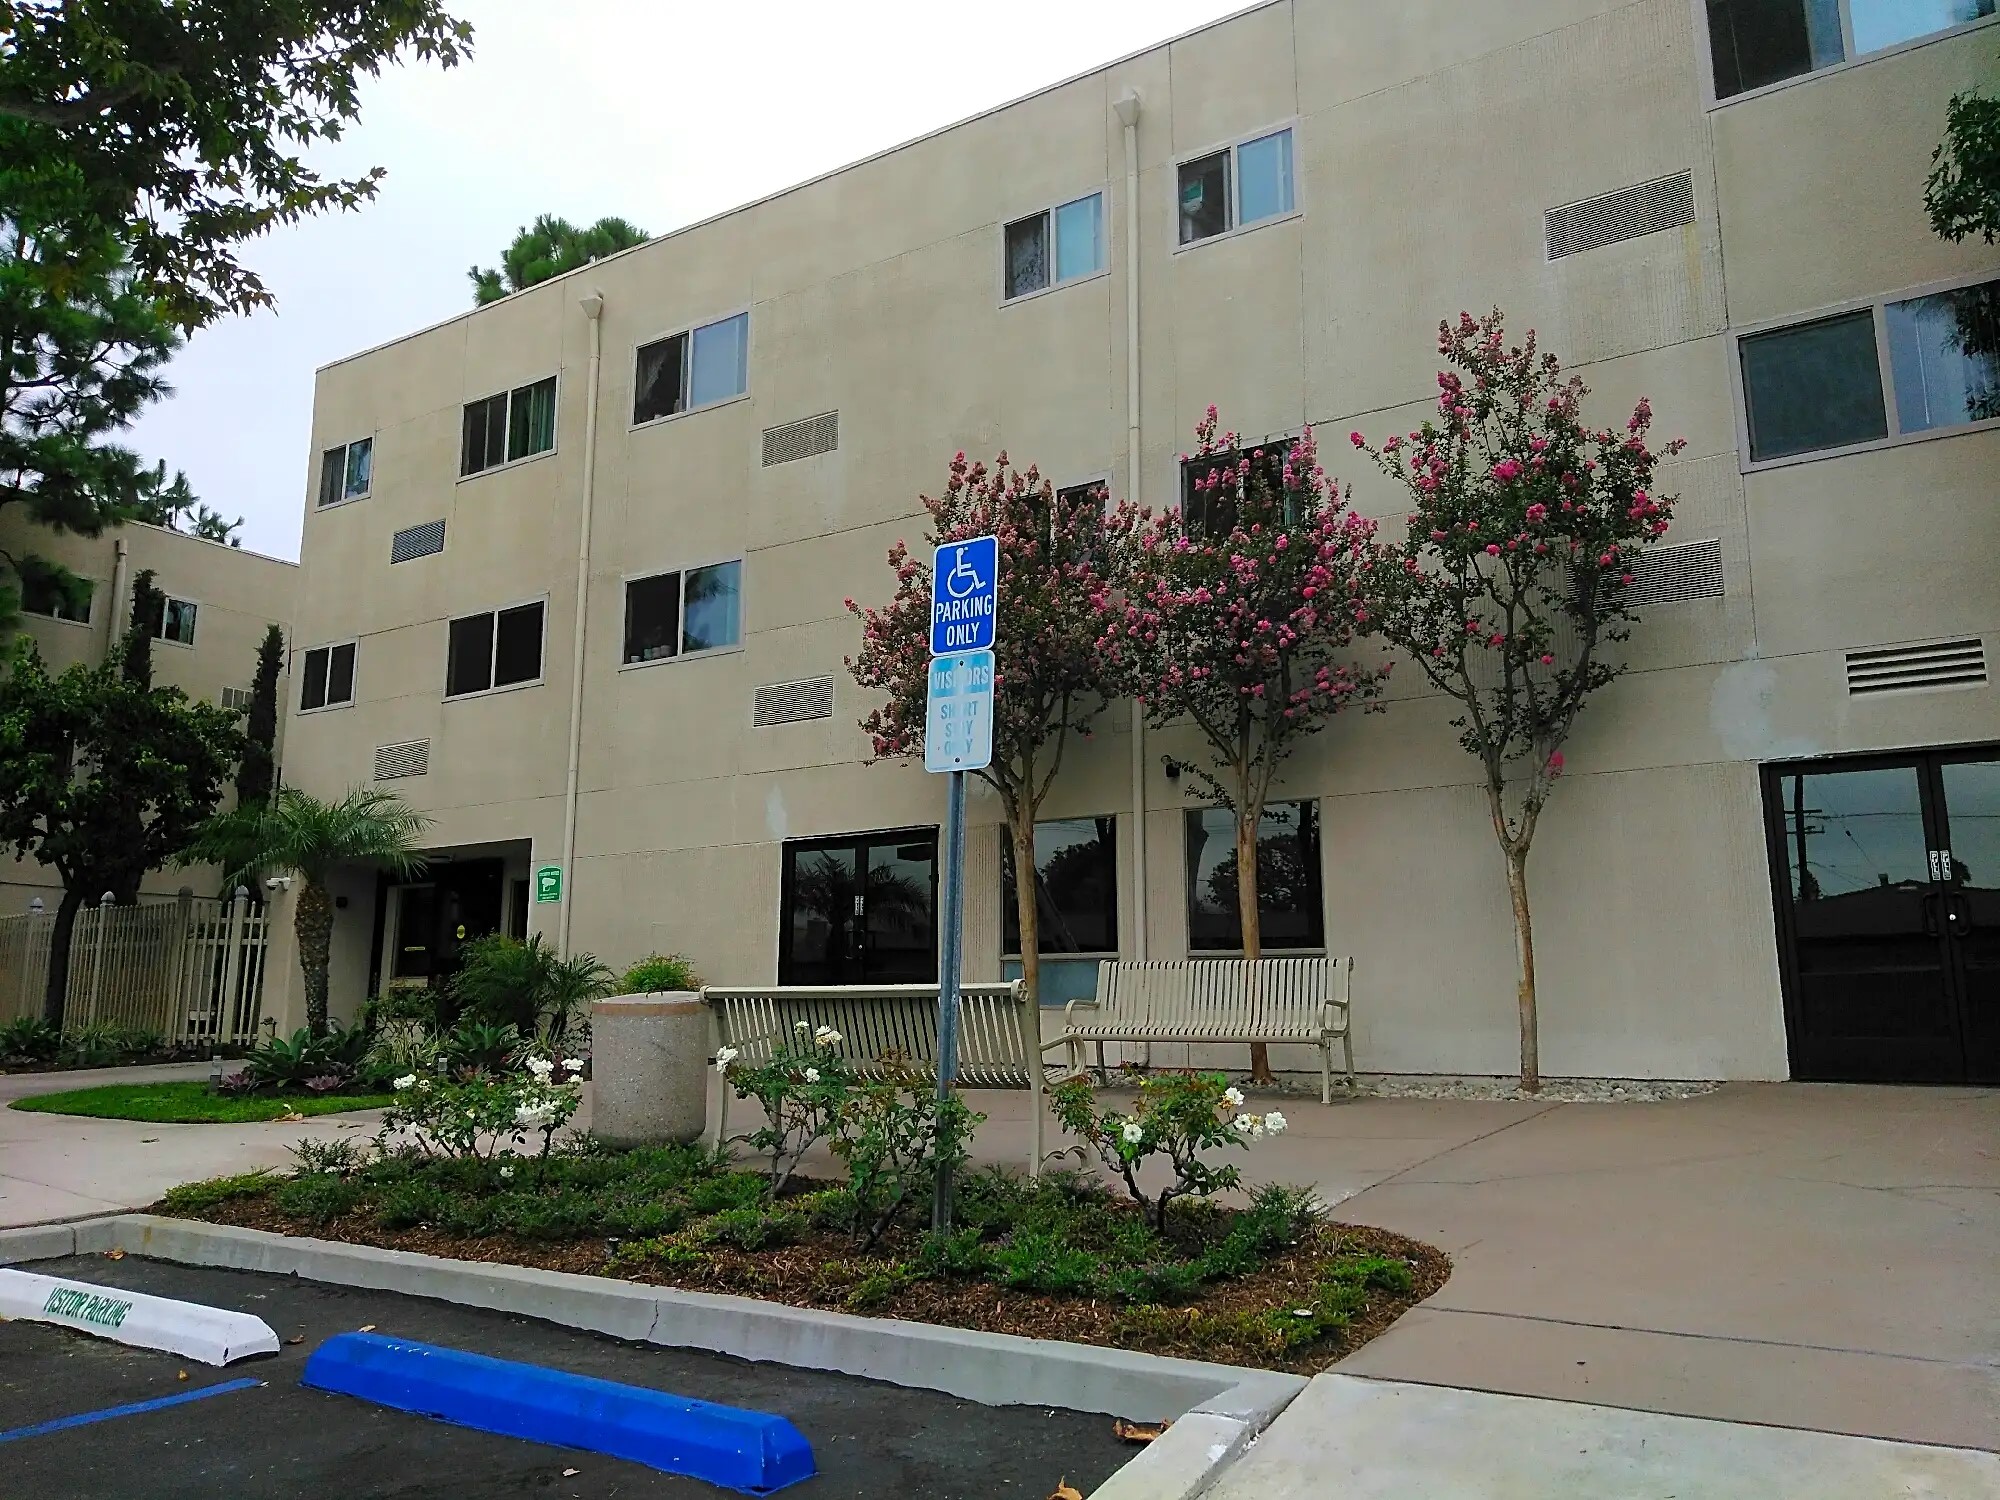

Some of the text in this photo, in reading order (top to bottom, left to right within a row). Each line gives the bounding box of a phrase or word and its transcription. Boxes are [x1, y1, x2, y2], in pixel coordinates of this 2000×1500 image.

[935, 594, 992, 624] PARKING
[946, 622, 980, 647] ONLY
[940, 700, 979, 720] SHRT
[43, 1287, 133, 1328] VISITOR PARKING
